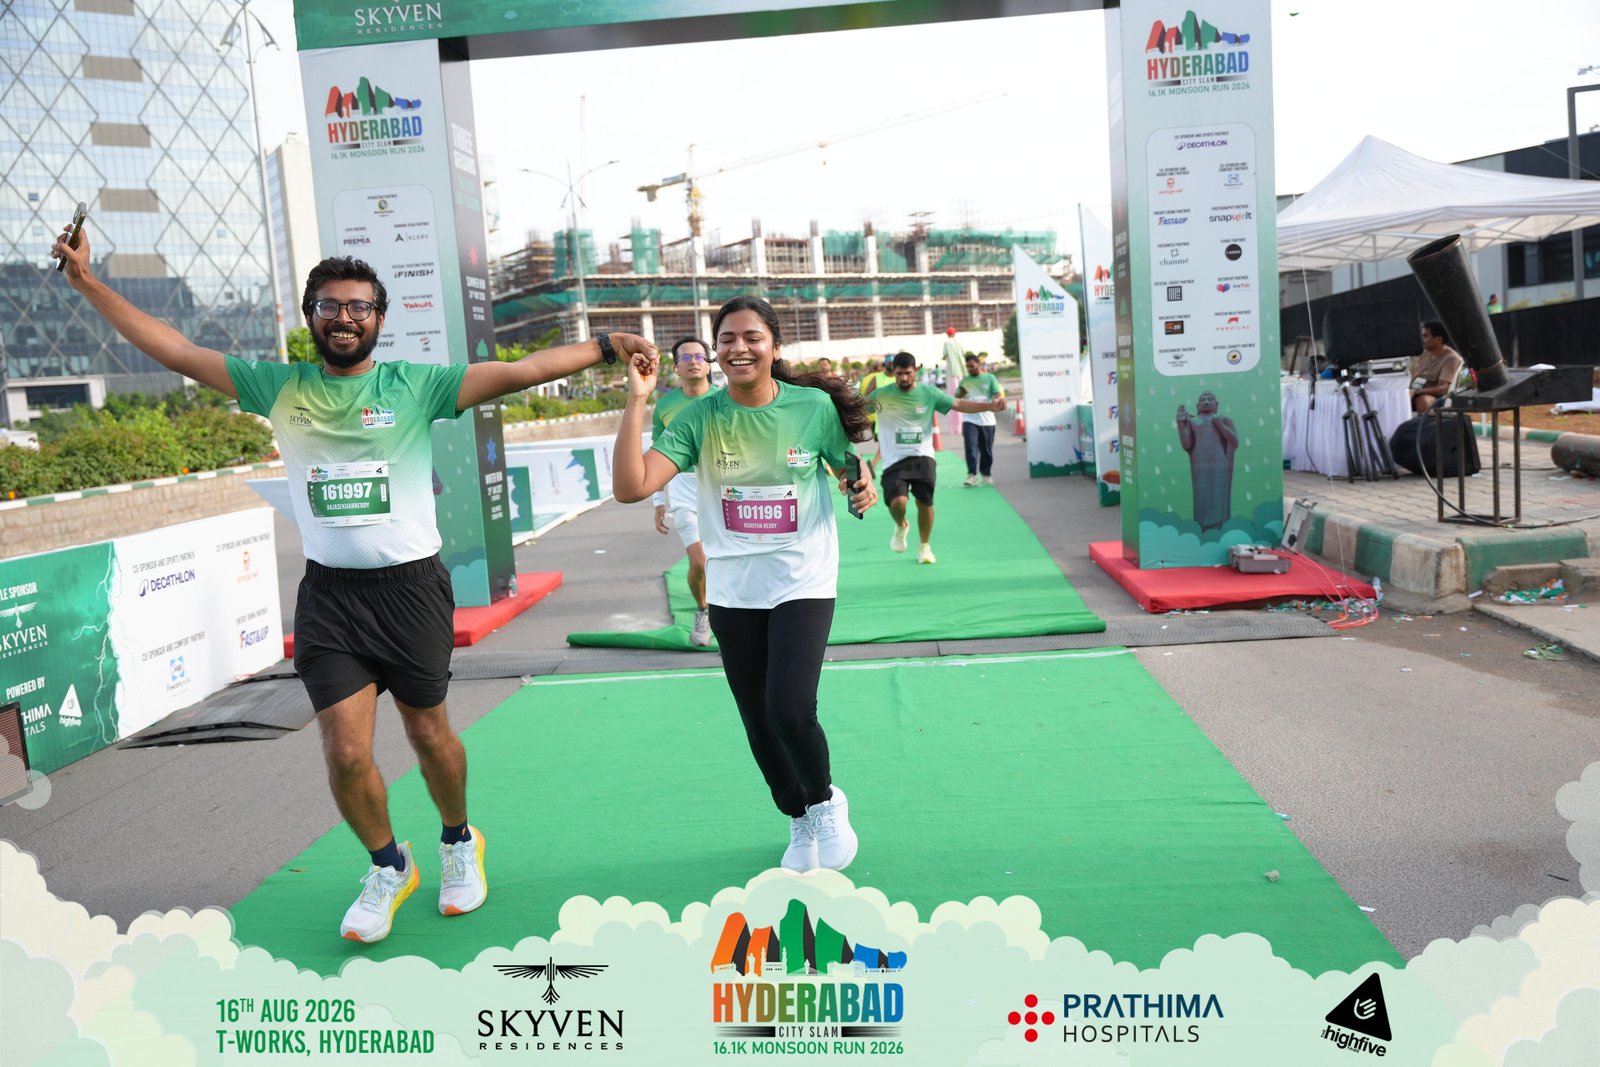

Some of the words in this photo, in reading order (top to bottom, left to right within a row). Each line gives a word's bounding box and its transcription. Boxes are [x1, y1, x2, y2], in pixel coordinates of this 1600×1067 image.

[354, 2, 442, 27] SKYVEN
[357, 22, 443, 35] RESIDENCES
[1147, 51, 1249, 80] HYDERABAD
[1182, 78, 1198, 86] CITY
[1199, 76, 1215, 84] SLAM
[1148, 86, 1167, 97] 16.1K
[1168, 84, 1210, 96] MONSOON
[1211, 83, 1229, 92] RUN
[1231, 82, 1250, 91] 2026
[327, 115, 423, 144] HYDERABAD
[1187, 139, 1227, 149] DECATHLON
[331, 151, 348, 160] 16.1K
[349, 148, 388, 158] MONSOON
[390, 147, 406, 155] RUN
[408, 145, 425, 154] 2026
[343, 237, 371, 246] PREMIA
[394, 269, 434, 279] iFINISH
[404, 301, 433, 309] Yakult
[1025, 302, 1064, 312] HYDERABAD
[289, 415, 312, 424] SKYVEN
[362, 415, 394, 424] HYDERABAD
[321, 482, 373, 501] 161997
[736, 504, 783, 520] 101196
[179, 551, 195, 563] PARTNER
[150, 569, 196, 592] DECATHLON
[8, 582, 38, 598] SPONSOR
[0, 624, 47, 652] KYVEN
[189, 631, 205, 644] PARTNER
[239, 626, 269, 650] FAST&UP
[0, 641, 48, 660] ESIDENCES
[6, 680, 37, 700] POWERED
[37, 676, 45, 690] BY
